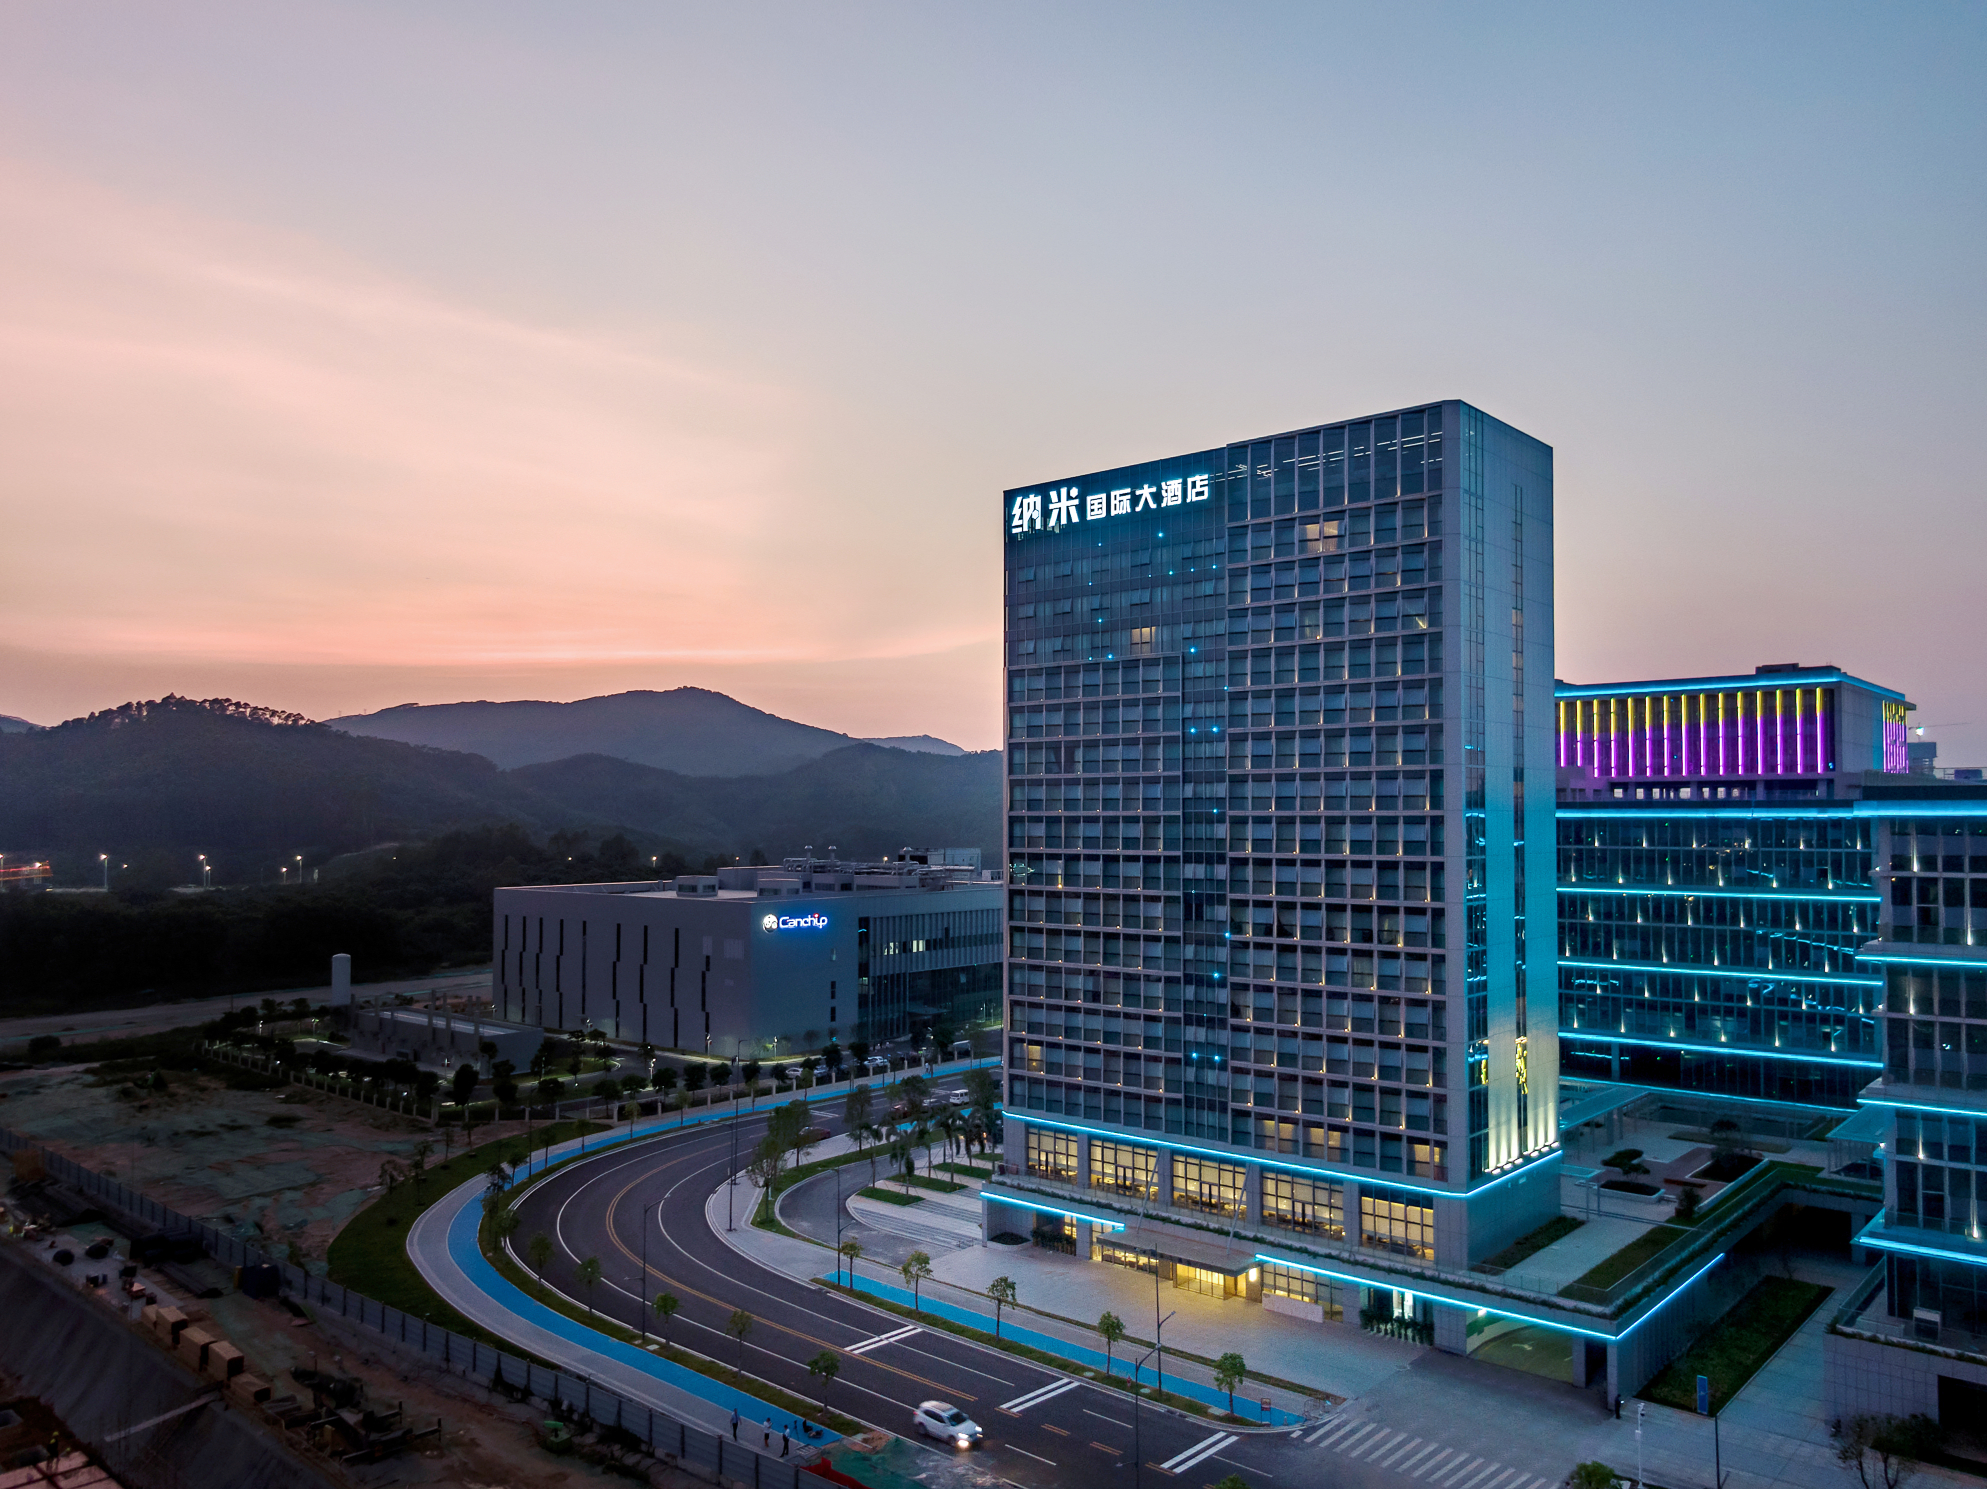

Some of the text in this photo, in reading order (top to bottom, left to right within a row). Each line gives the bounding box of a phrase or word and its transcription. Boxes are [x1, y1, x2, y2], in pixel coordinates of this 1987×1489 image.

[1011, 474, 1209, 534] 纳米国际大酒店
[779, 913, 828, 929] Canchip
